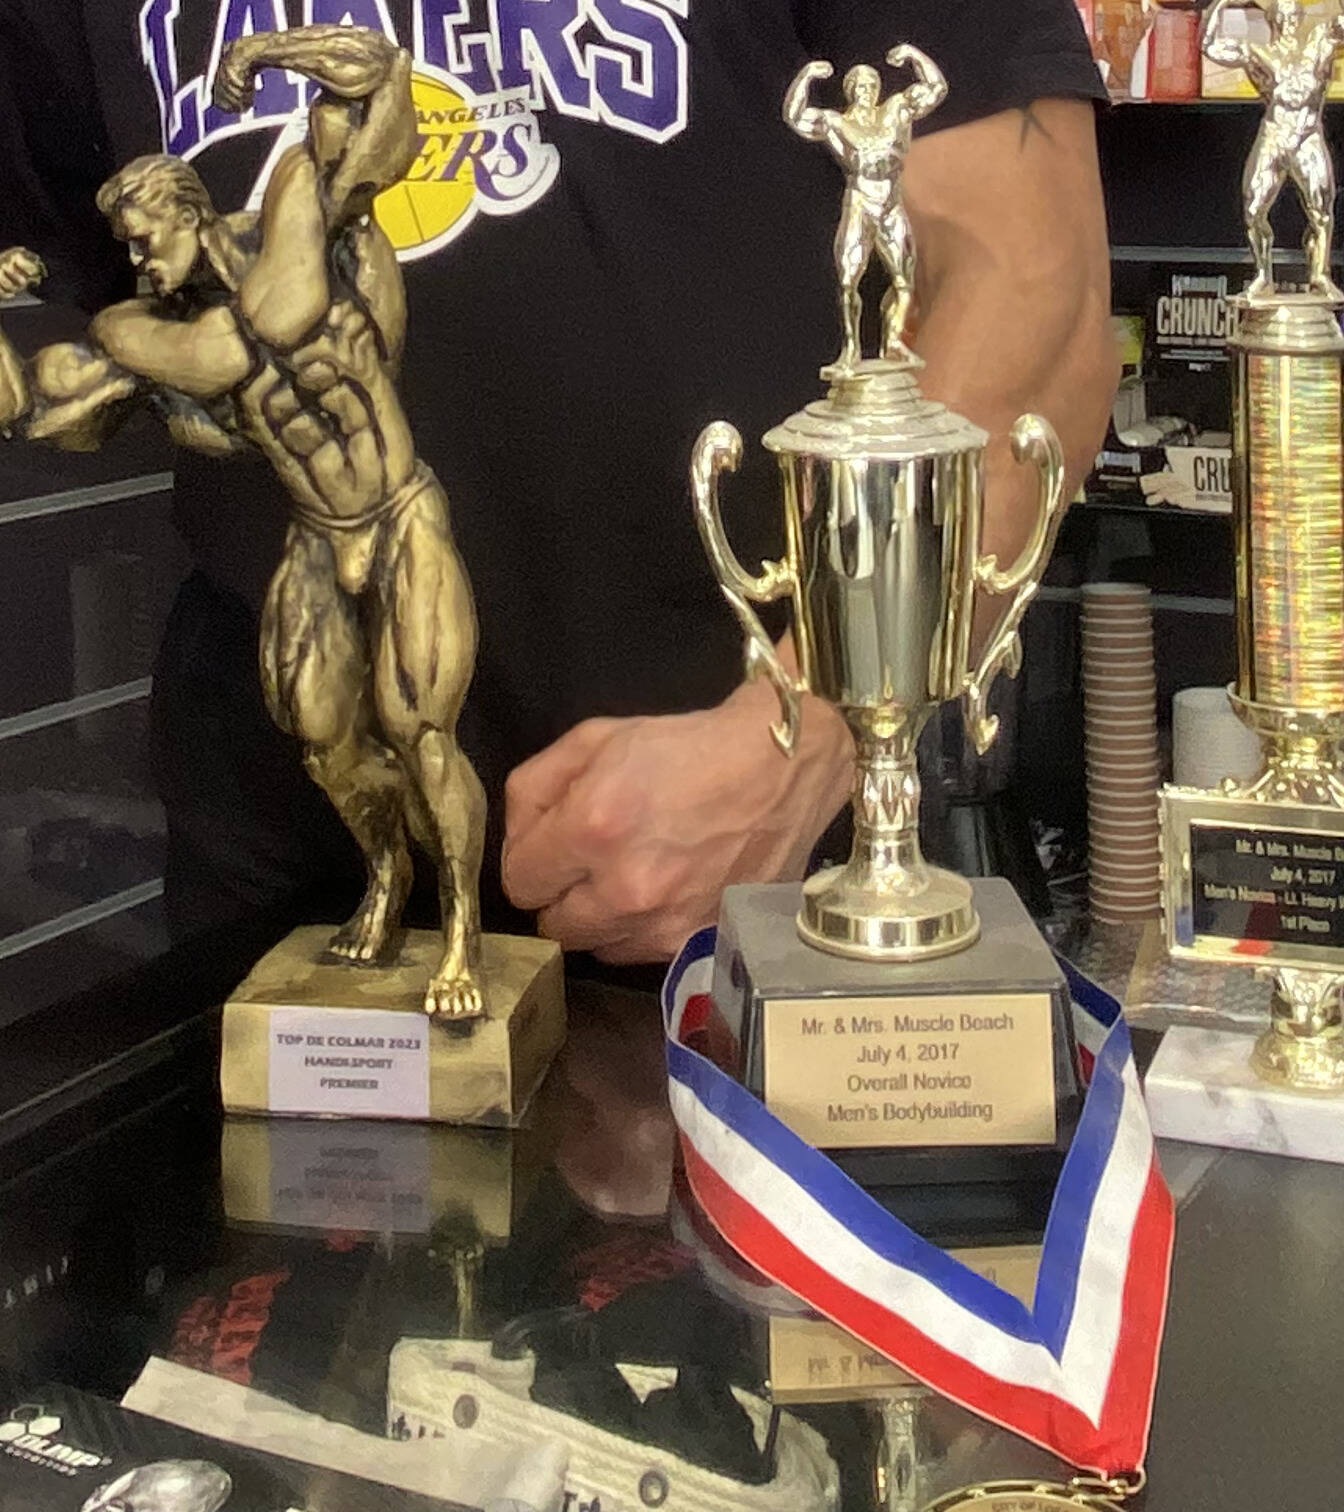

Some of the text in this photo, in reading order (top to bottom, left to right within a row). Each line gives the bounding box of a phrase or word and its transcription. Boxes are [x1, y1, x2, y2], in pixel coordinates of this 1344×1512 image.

[405, 124, 549, 201] ERS
[1157, 295, 1240, 338] CRUNCH
[1193, 455, 1232, 492] CRU
[801, 1013, 1014, 1036] Mr. & Mrs. Muscle Beach
[276, 1034, 421, 1050] TOP DE COLMAR 2023
[857, 1045, 891, 1066] July
[918, 1043, 960, 1061] 2017
[320, 1077, 379, 1089] PREMIER
[847, 1072, 972, 1092] Overall Novice
[827, 1102, 993, 1122] Men's Bodybuilding
